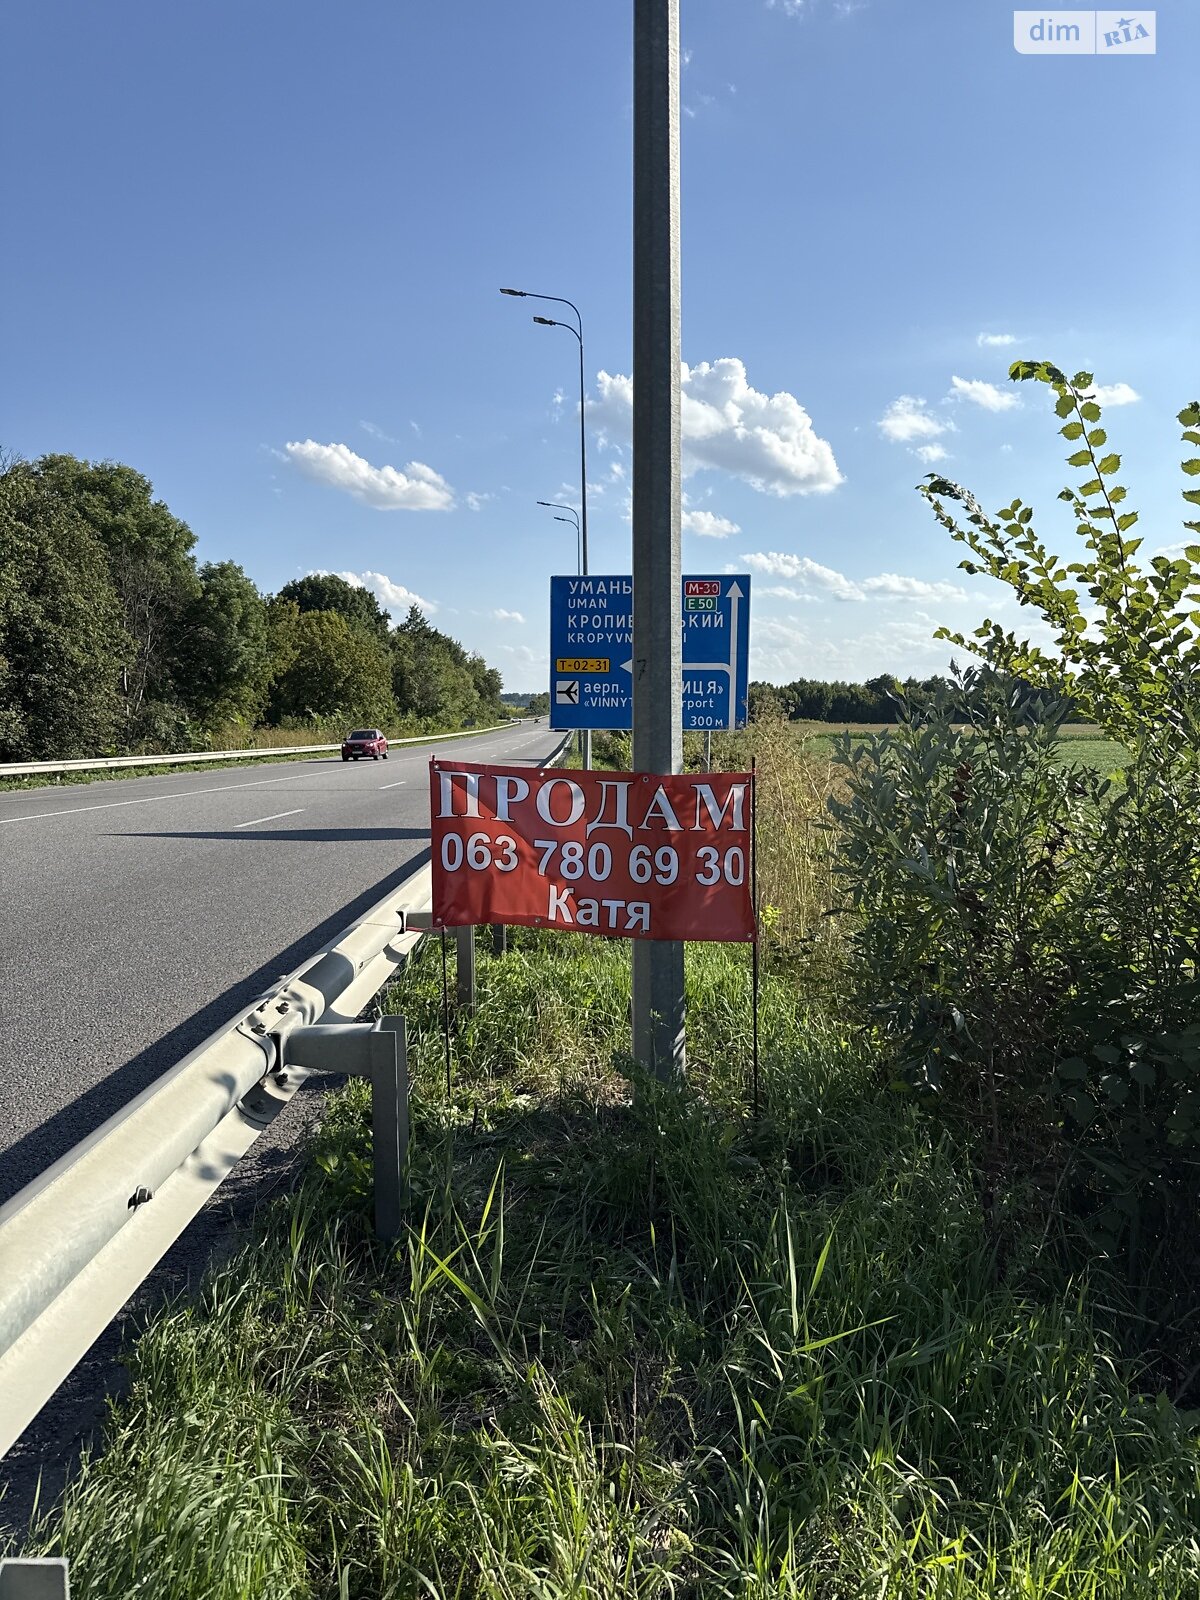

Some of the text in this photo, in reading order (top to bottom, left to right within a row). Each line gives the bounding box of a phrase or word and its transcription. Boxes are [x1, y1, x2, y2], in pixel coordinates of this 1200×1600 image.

[568, 581, 632, 594] УМАНЬ
[568, 598, 607, 608] UMAN
[584, 683, 624, 696] аерп.
[690, 716, 713, 726] 300
[435, 770, 749, 841] ПРОДАМ
[441, 832, 745, 886] 063 780 69 30
[547, 884, 650, 931] Катя
